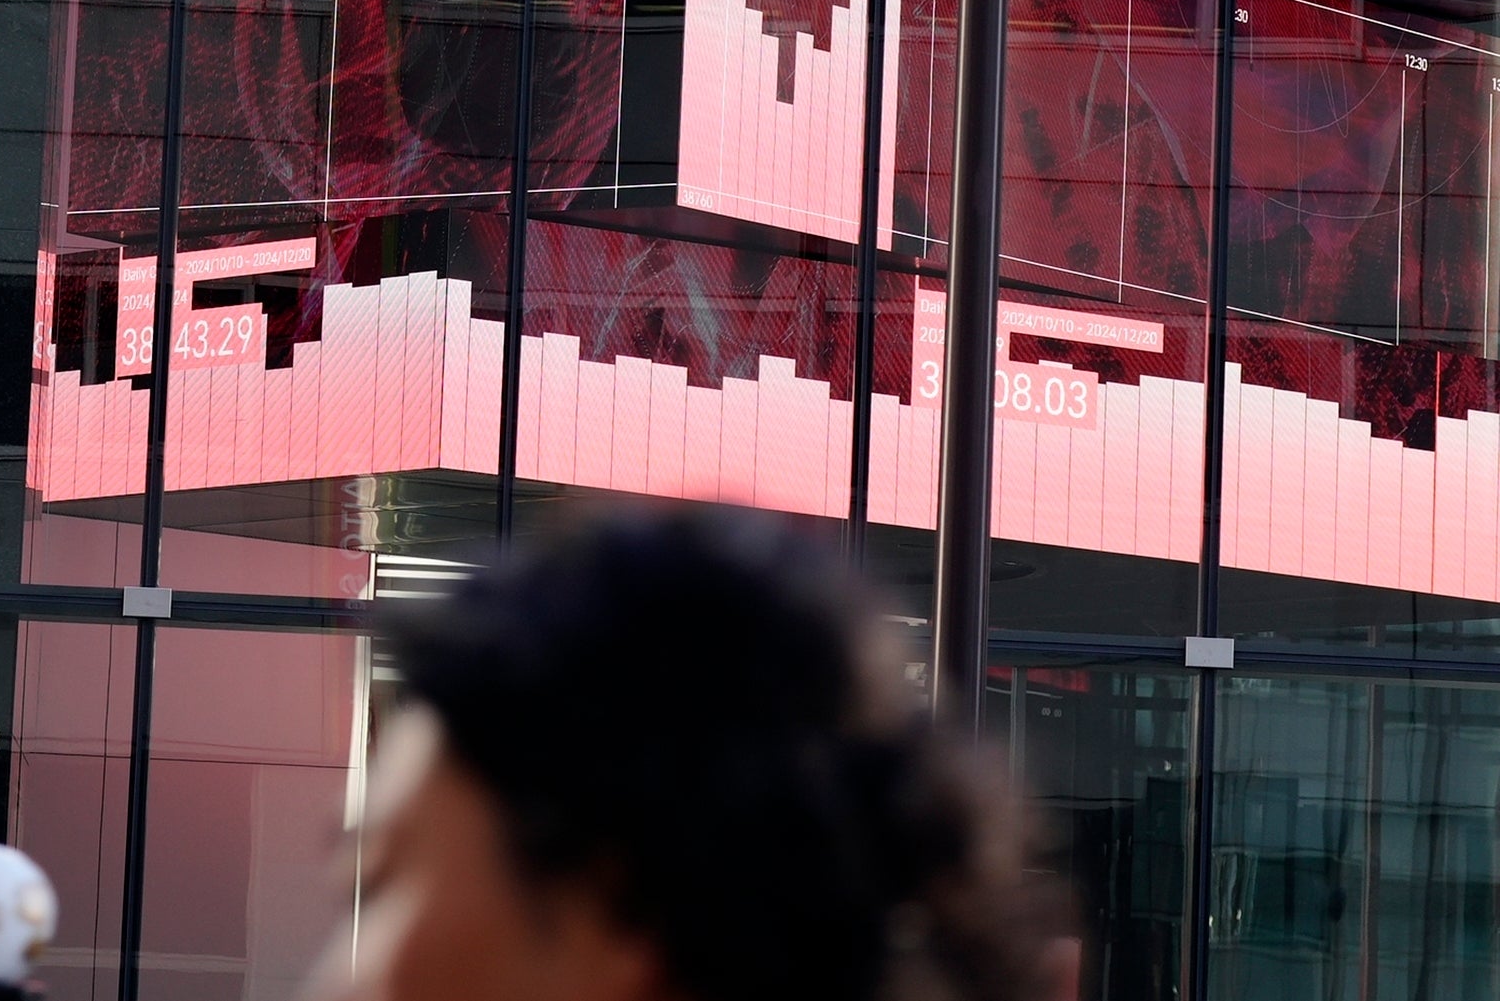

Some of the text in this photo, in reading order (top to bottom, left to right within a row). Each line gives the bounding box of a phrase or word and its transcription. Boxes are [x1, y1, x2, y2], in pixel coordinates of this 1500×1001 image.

[1405, 54, 1428, 71] 12:30
[682, 190, 713, 208] 38760
[123, 267, 147, 284] Daily
[186, 255, 243, 275] 2024/10/10
[253, 247, 311, 267] 2024/12/20
[123, 290, 188, 311] 2024/24
[121, 315, 253, 366] 3843.29
[1002, 311, 1074, 333] 2024/10/10
[1086, 323, 1157, 345] 2024/12/20
[919, 360, 1088, 419] 308.03
